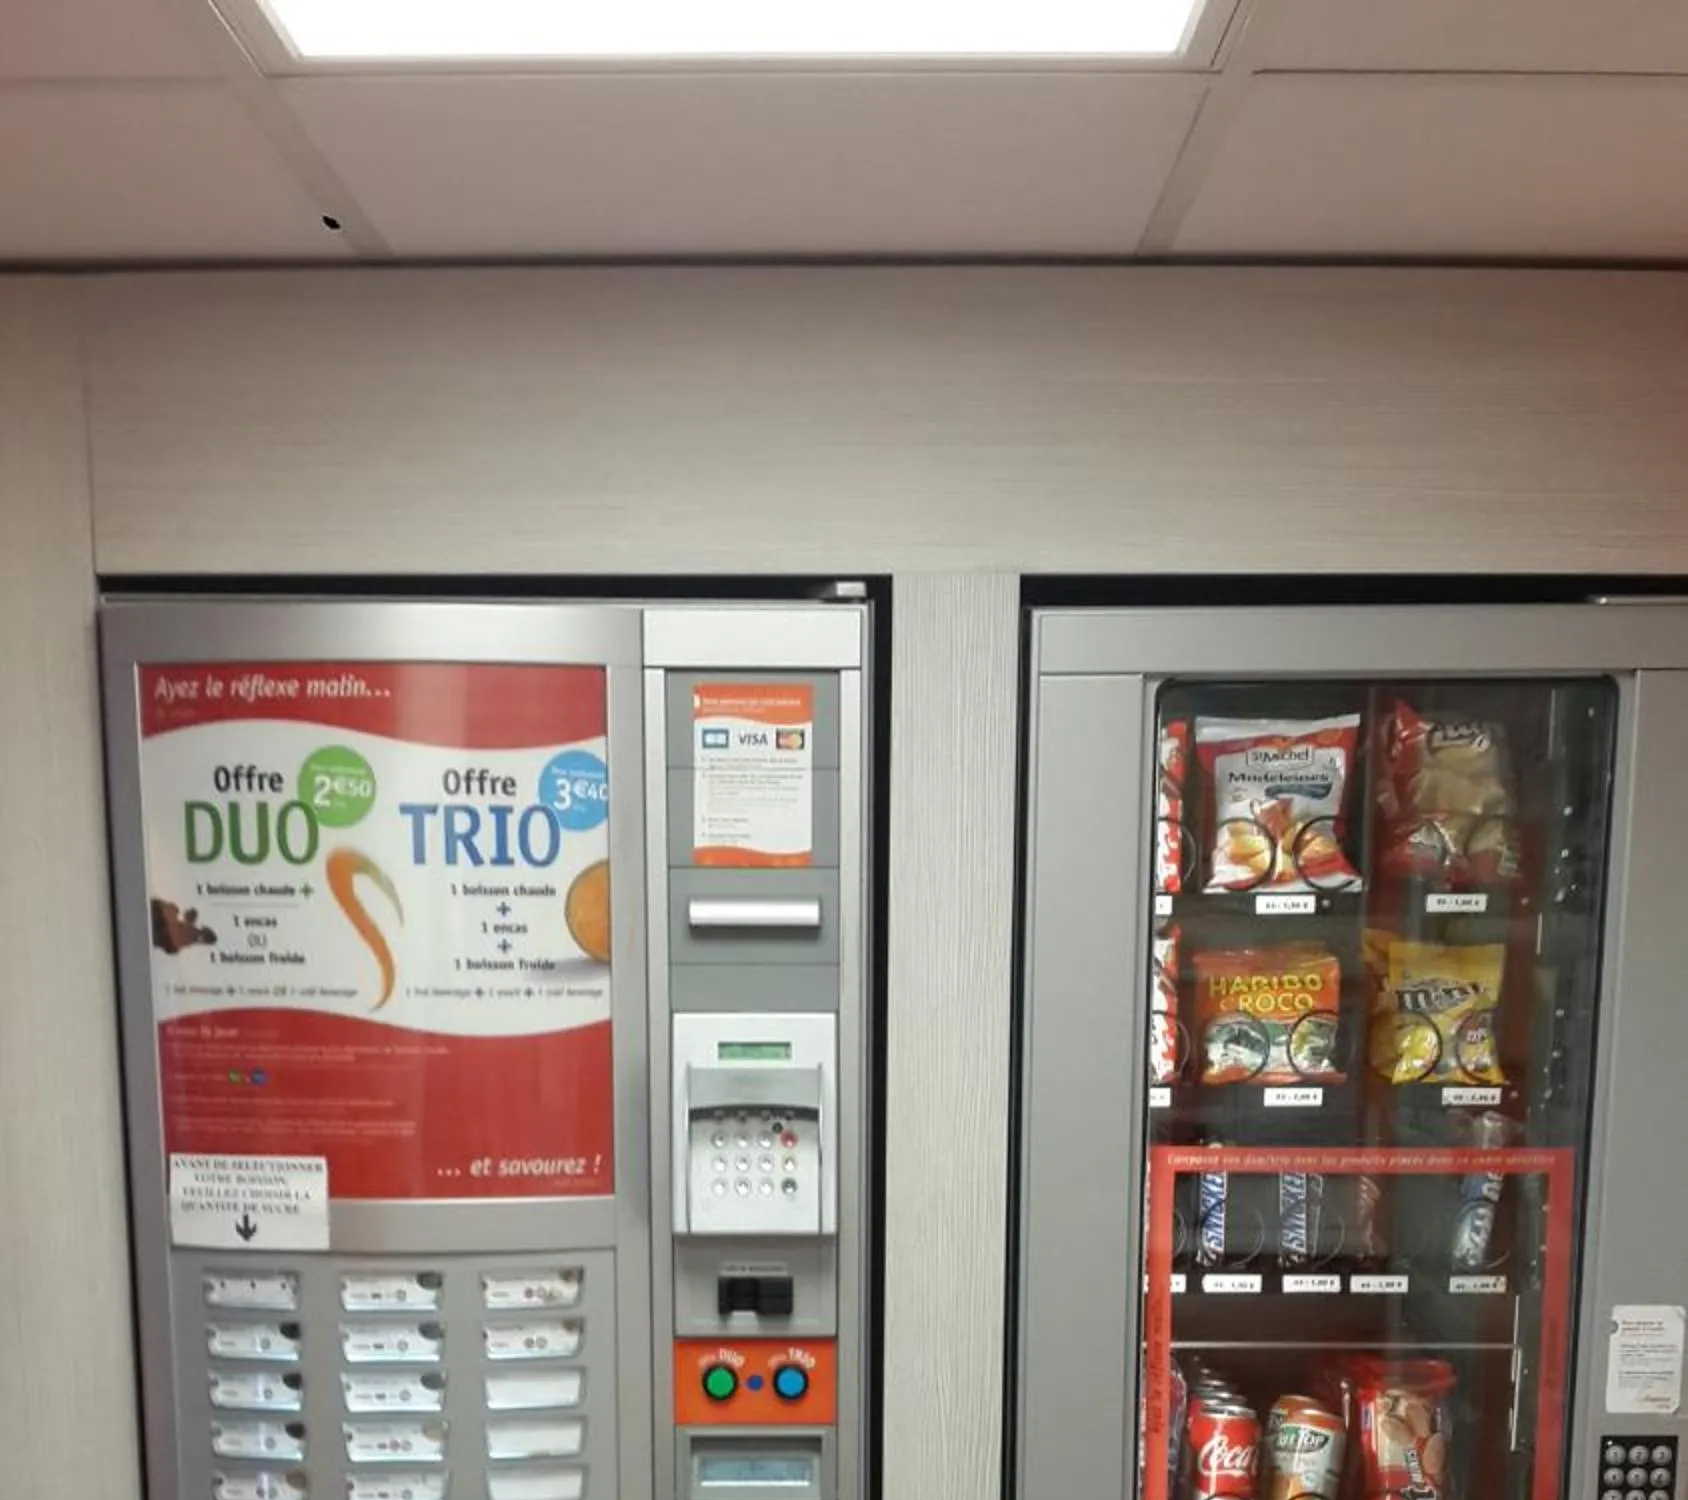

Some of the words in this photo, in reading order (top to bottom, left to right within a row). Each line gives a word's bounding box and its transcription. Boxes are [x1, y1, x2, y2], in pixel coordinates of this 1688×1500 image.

[155, 675, 198, 703] Ayez
[206, 674, 224, 698] le
[231, 674, 300, 703] réflexe
[739, 733, 769, 746] VISA
[214, 765, 284, 792] Offre
[442, 768, 517, 796] Offre
[184, 800, 319, 866] DUO
[399, 804, 561, 868] TRIO
[463, 884, 510, 897] boisson
[513, 884, 556, 897] chaude
[1210, 974, 1323, 996] HARIBO
[1220, 992, 1313, 1013] CROCO
[470, 1156, 492, 1177] et
[499, 1157, 586, 1176] savourez
[1199, 1434, 1259, 1476] Coca
